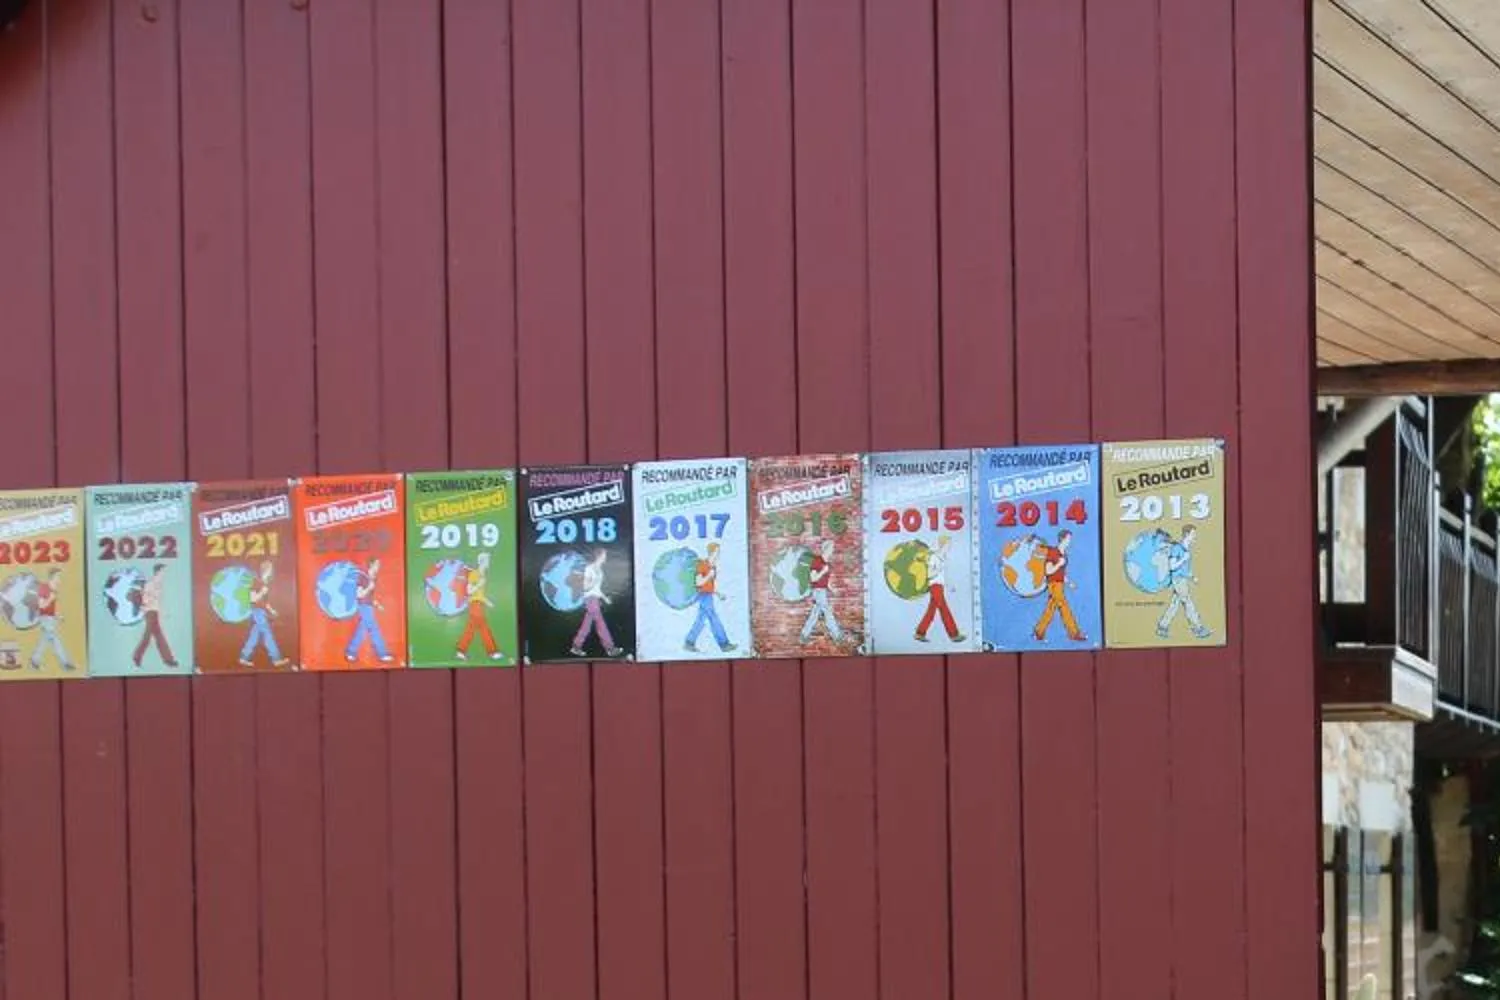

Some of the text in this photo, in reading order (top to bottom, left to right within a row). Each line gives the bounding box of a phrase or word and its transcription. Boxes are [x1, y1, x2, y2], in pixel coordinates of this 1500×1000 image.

[948, 461, 969, 473] PAR
[990, 449, 1091, 469] RECOMMANDÉ PAR
[604, 471, 625, 483] PAR
[641, 465, 738, 484] RECOMMANDÉ PAR
[992, 466, 1087, 498] Le Routard
[1117, 461, 1210, 492] Le Routard
[420, 491, 504, 521] Le Routard
[533, 485, 620, 516] Le Routard
[645, 481, 733, 513] Le Routard
[762, 478, 847, 509] Le Routard
[1119, 492, 1211, 522] 2013
[115, 506, 178, 529] Routard
[204, 501, 285, 531] Le Routard
[309, 495, 392, 526] Le Routard
[767, 510, 848, 538] 2016
[881, 506, 965, 533] 2015
[996, 496, 1089, 528] 2014
[420, 524, 499, 549] 2019
[536, 517, 617, 544] 2018
[649, 513, 730, 540] 2017
[0, 540, 70, 565] 2023
[98, 535, 178, 561] 2022
[207, 531, 279, 557] 2021
